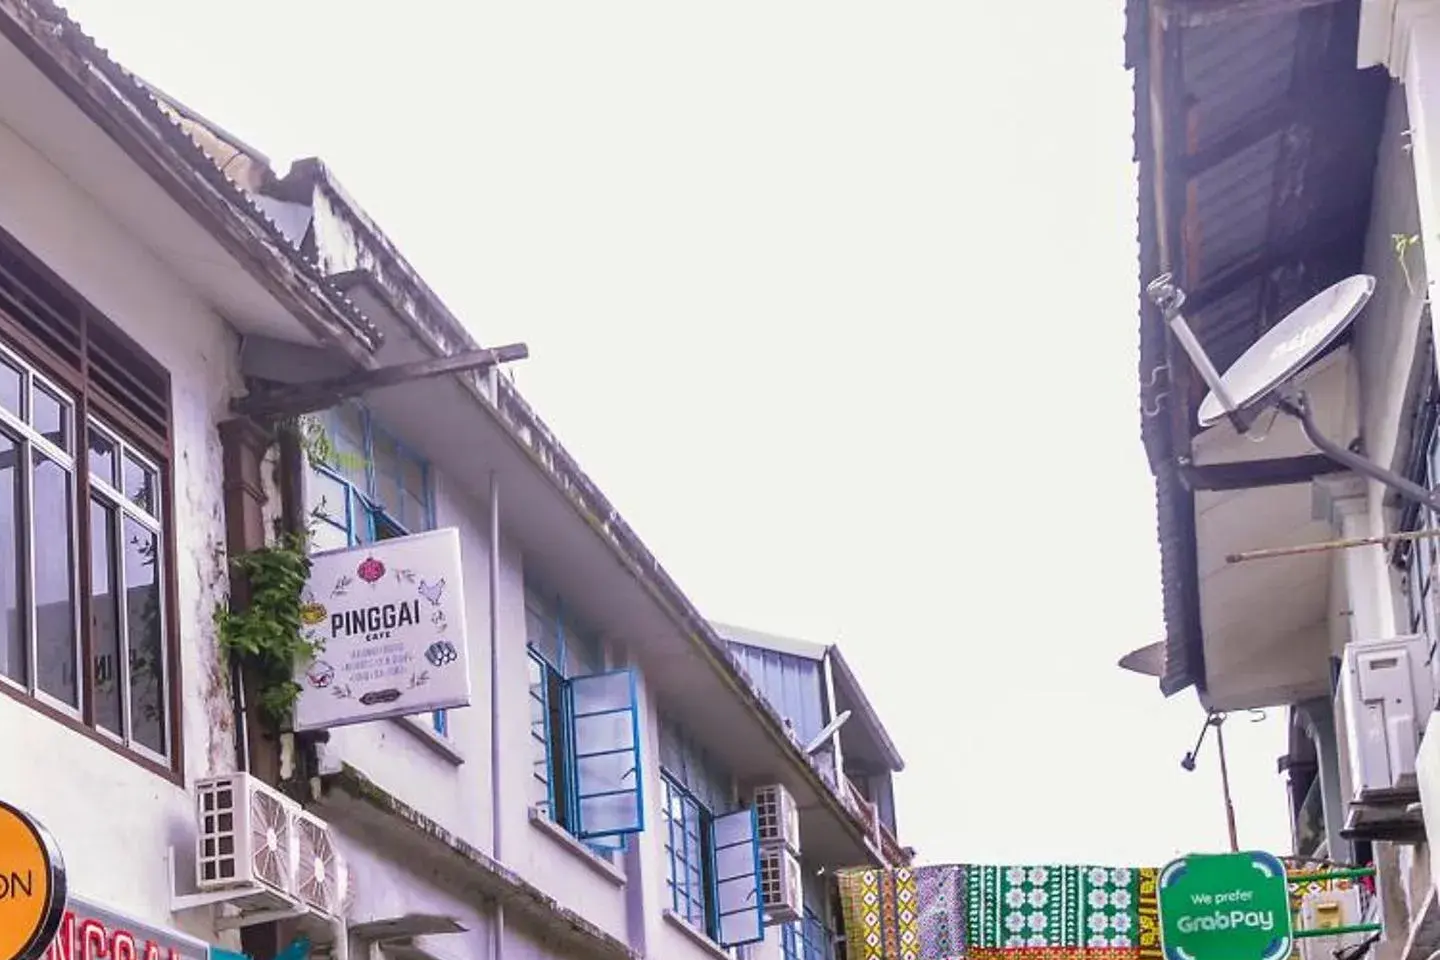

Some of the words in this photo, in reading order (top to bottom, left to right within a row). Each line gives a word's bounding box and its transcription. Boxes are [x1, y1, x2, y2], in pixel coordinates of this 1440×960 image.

[331, 599, 420, 638] PINGGAI
[366, 631, 391, 642] CAFE
[1190, 893, 1212, 905] We
[1215, 889, 1253, 905] prefer
[1177, 910, 1274, 933] GrabPay
